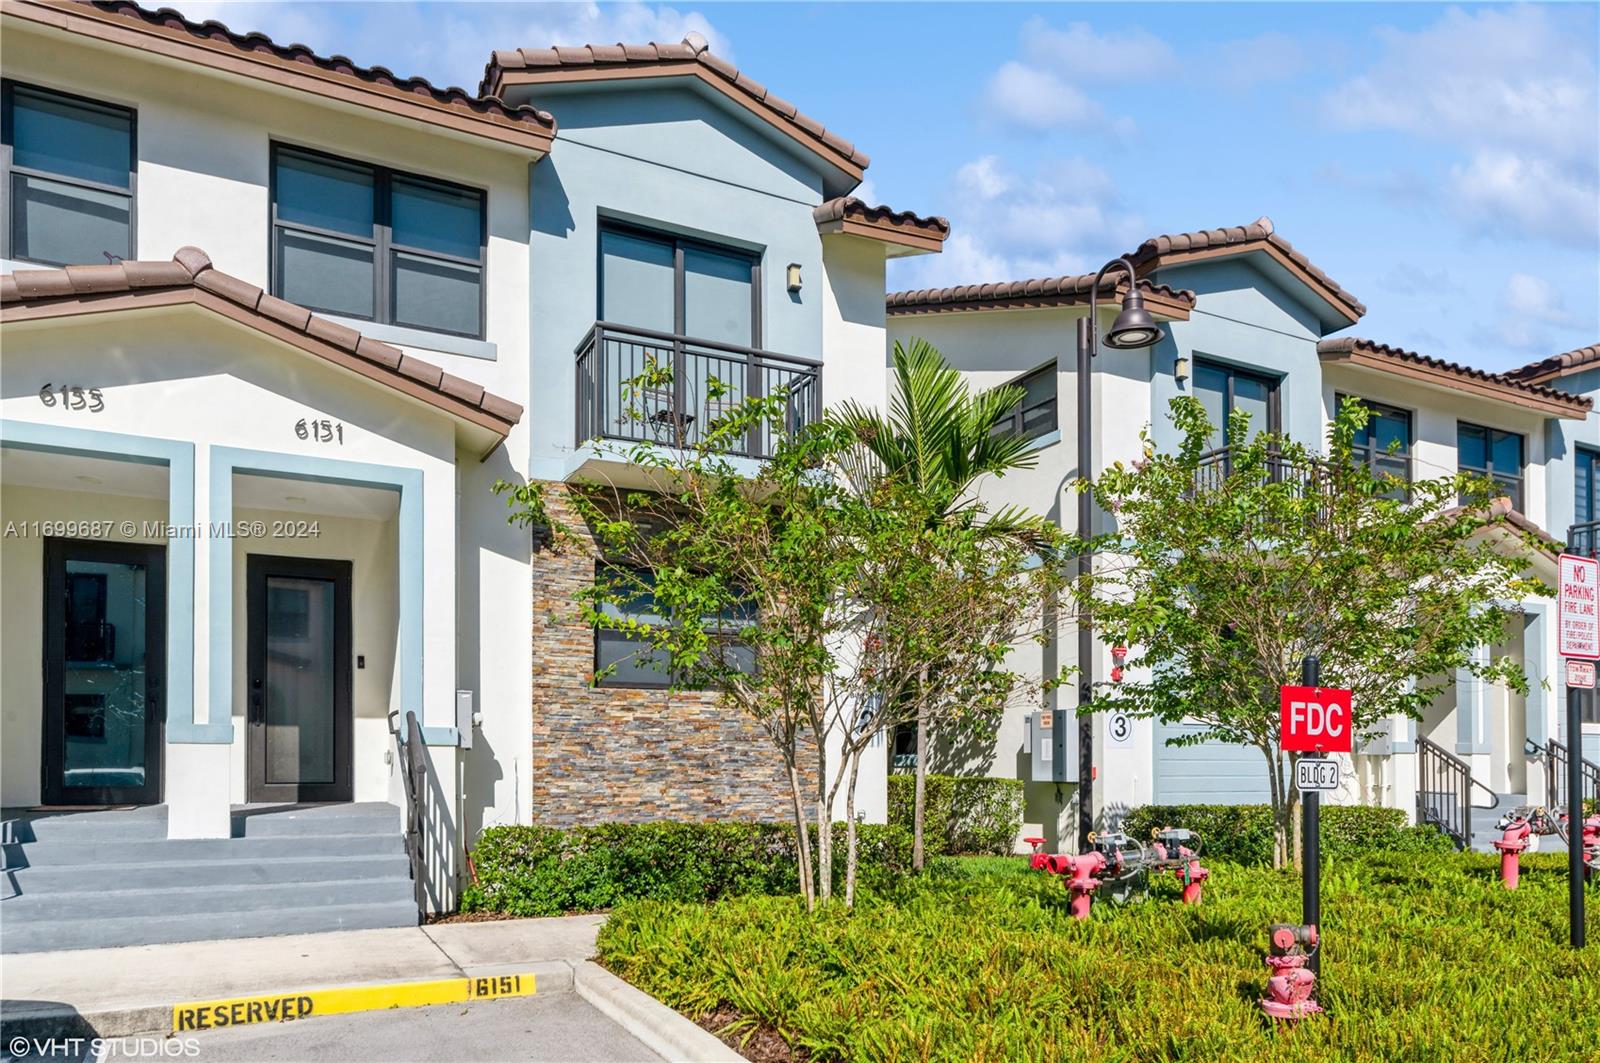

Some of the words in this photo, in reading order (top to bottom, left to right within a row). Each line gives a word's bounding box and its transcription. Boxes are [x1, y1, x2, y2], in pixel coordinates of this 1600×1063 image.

[294, 418, 343, 445] 6151
[1573, 564, 1586, 583] NO
[1564, 583, 1595, 602] PARKING
[1564, 600, 1578, 614] FIRE
[1579, 603, 1595, 616] LANE
[1564, 620, 1572, 629] BY
[1572, 621, 1587, 631] ORDER
[1115, 716, 1127, 737] 3
[1290, 701, 1343, 738] FDC
[1300, 766, 1326, 784] BLDG
[1329, 767, 1336, 784] 2
[476, 975, 520, 996] 6151
[178, 995, 313, 1031] RESERVED
